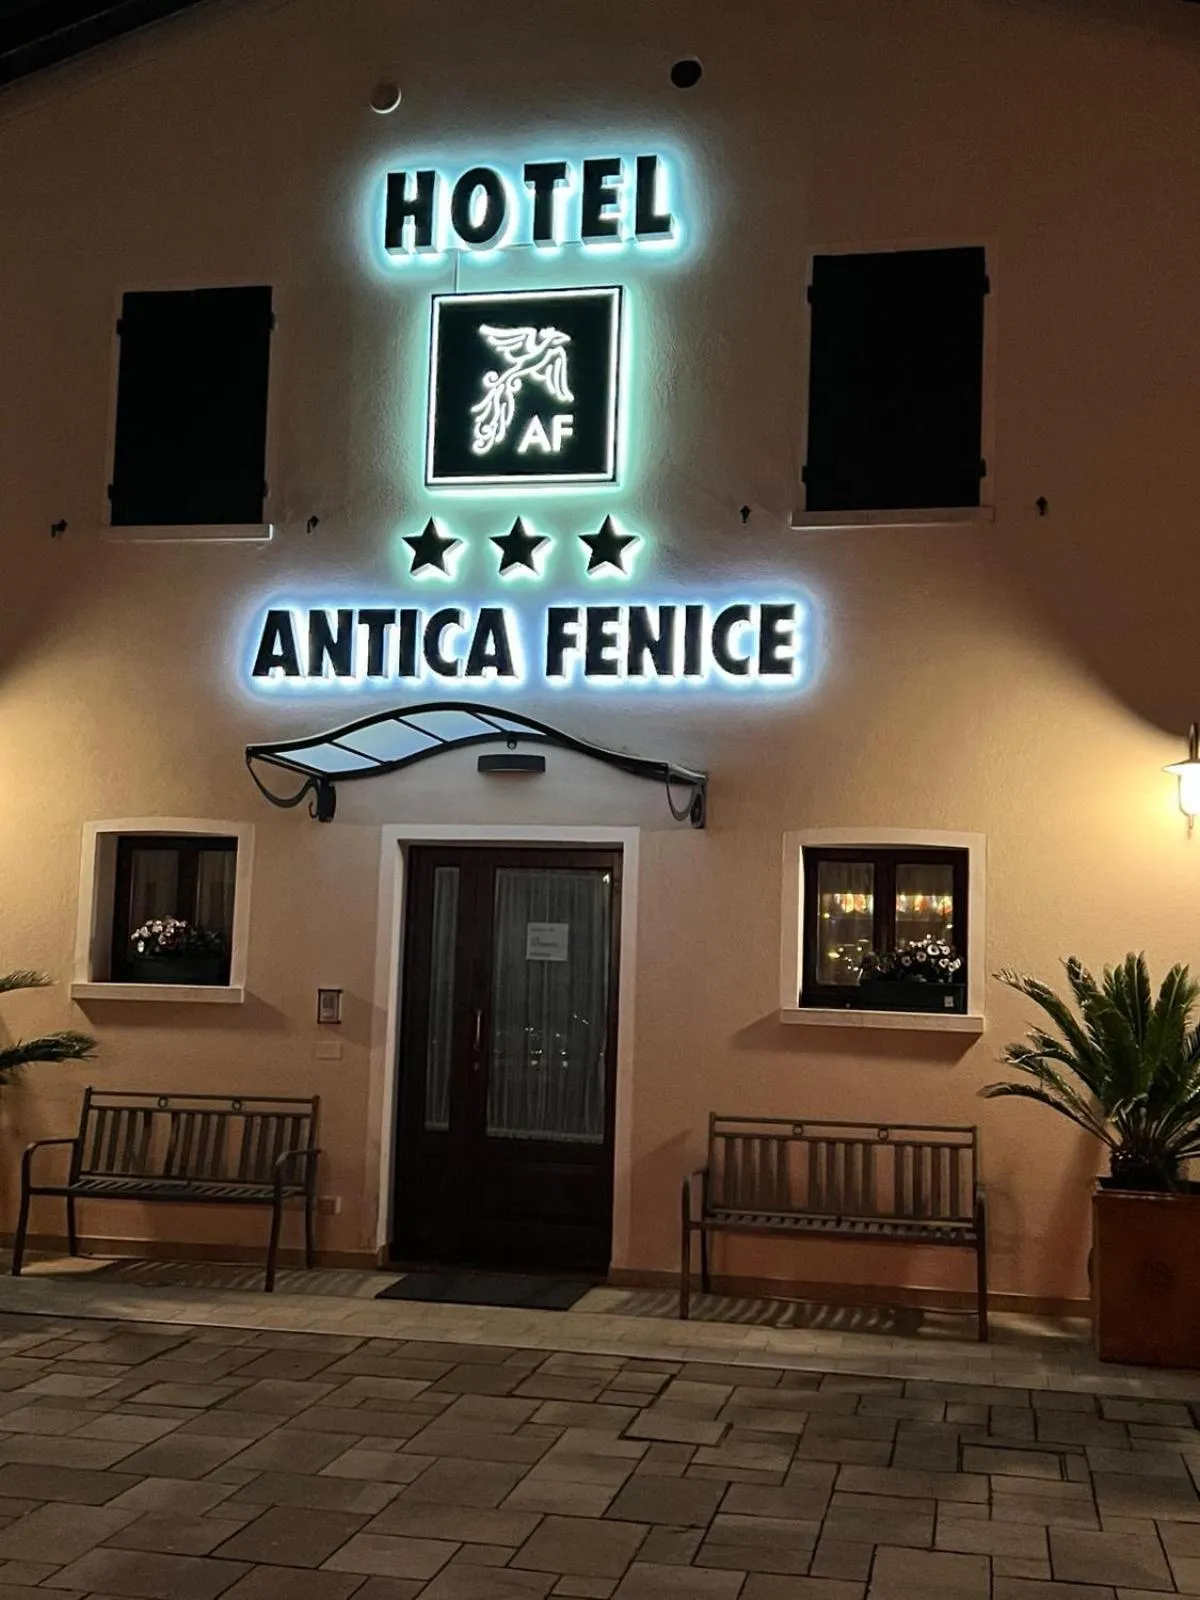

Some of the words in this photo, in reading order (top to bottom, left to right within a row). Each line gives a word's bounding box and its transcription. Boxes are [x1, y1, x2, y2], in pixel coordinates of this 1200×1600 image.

[385, 154, 674, 250] HOTEL
[517, 413, 575, 454] AF
[252, 607, 518, 678] ANTICA
[546, 602, 797, 677] FENICE
